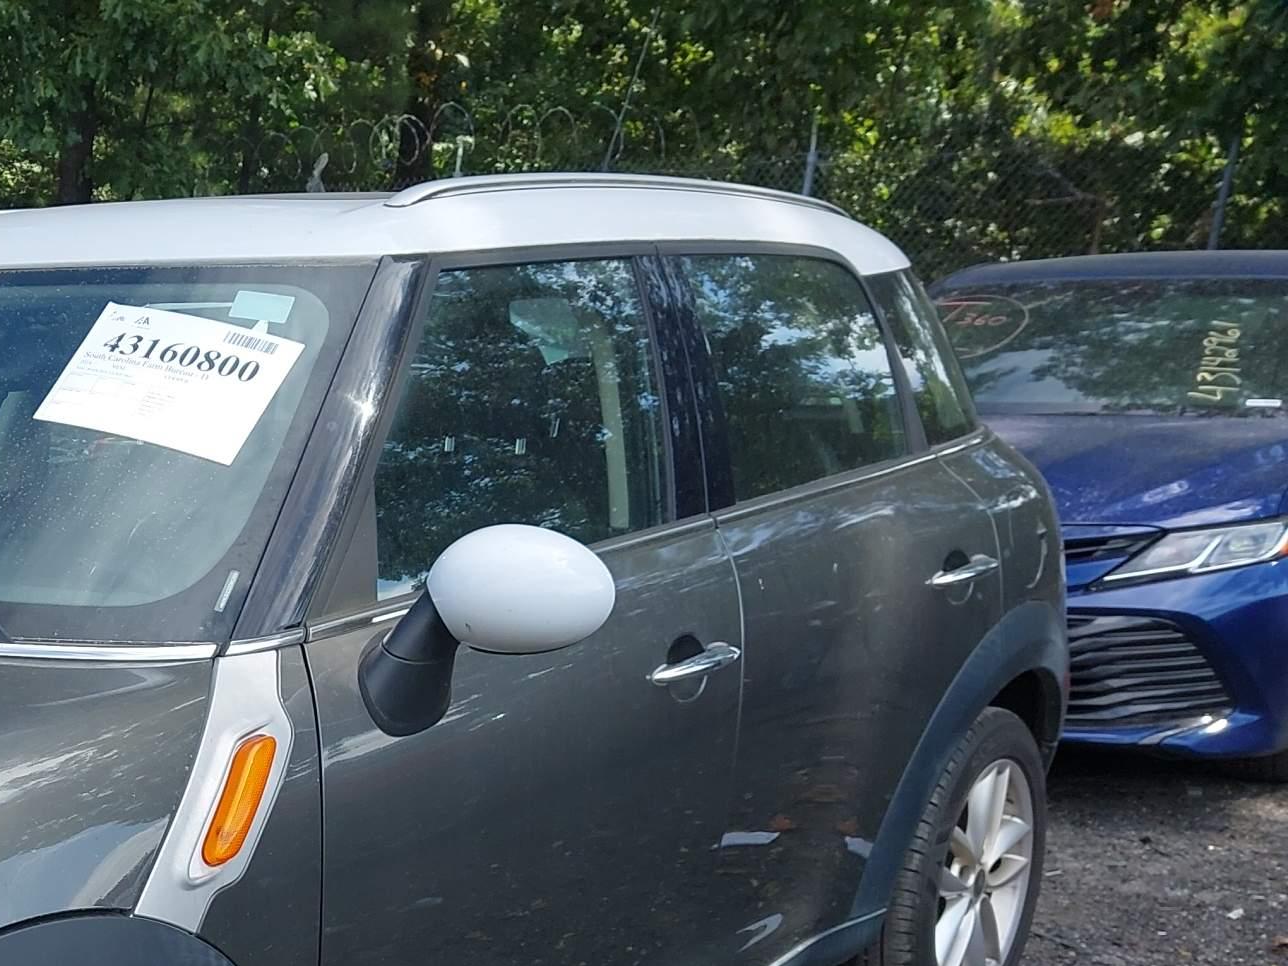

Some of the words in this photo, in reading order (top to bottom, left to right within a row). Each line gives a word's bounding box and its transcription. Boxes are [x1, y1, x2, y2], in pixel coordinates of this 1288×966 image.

[83, 351, 108, 363] South
[107, 353, 142, 368] Carolina
[103, 332, 261, 382] 43160800
